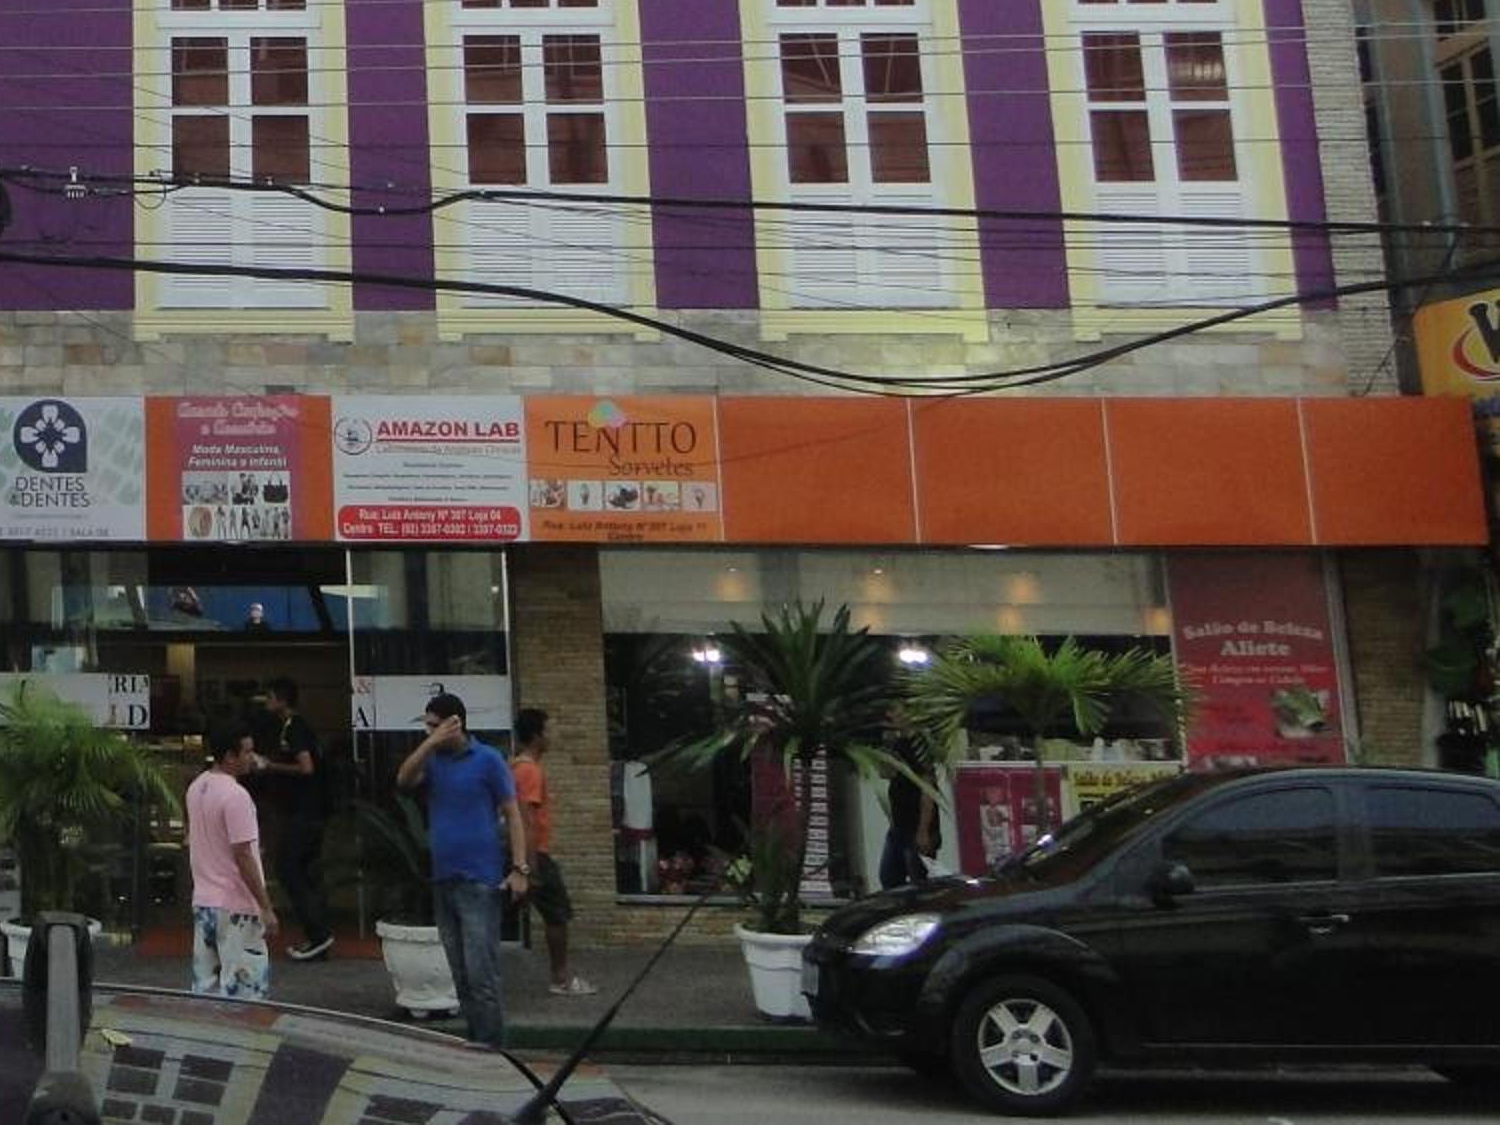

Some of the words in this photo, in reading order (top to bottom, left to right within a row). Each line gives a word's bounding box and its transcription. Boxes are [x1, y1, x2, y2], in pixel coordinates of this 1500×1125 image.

[377, 422, 468, 437] AMAZON
[475, 422, 519, 437] LAB
[544, 419, 697, 459] TENTTO
[609, 455, 694, 477] Sorvetes
[15, 476, 85, 491] DENTES
[1183, 622, 1234, 640] Salão
[1237, 620, 1258, 634] de
[1263, 620, 1324, 640] Beleza
[1219, 640, 1291, 656] Aliete
